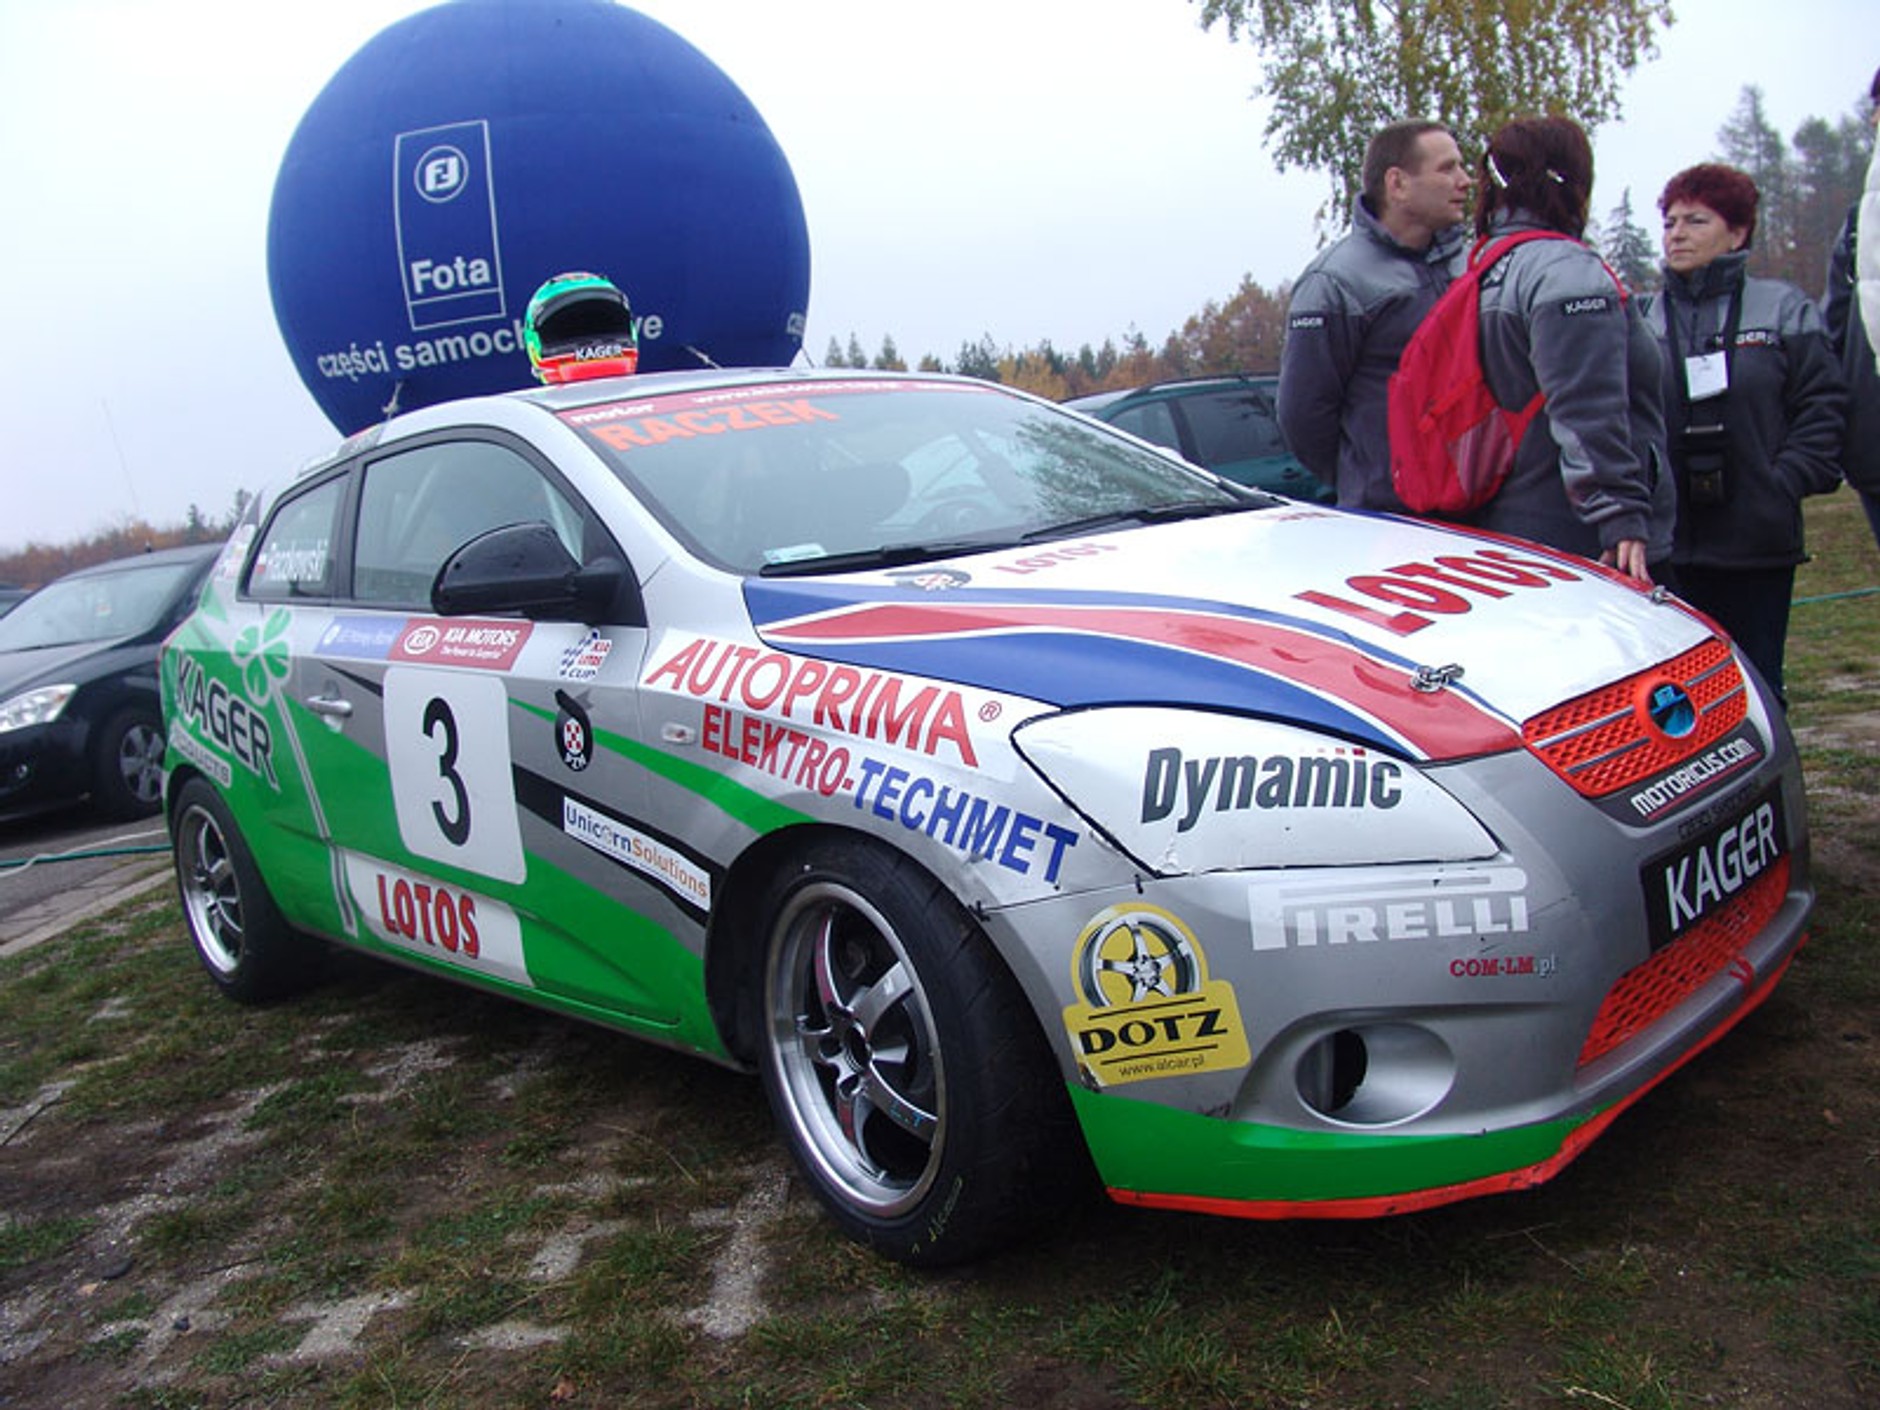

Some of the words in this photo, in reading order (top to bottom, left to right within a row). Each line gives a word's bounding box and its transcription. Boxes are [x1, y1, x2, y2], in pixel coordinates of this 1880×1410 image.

[410, 257, 491, 294] Fota
[317, 340, 390, 381] części
[575, 344, 622, 362] KAGER
[590, 400, 840, 450] RACZEK
[1290, 550, 1584, 638] LOTOS
[444, 627, 463, 642] KIA
[463, 628, 518, 647] MOTORS
[174, 645, 281, 793] KAGER
[645, 638, 979, 768] AUTOPRIMA
[423, 697, 471, 846] 3
[702, 703, 1079, 883] ELEKTRO-TECHMET
[1141, 747, 1402, 832] Dynamic
[1665, 801, 1778, 931] KAGER
[377, 874, 480, 959] LOTOS
[1248, 867, 1530, 950] PIRELLI
[1450, 955, 1557, 979] COM-LM.pl
[1079, 1008, 1228, 1055] DOTZ
[1119, 1054, 1205, 1077] www.alcar.pl
